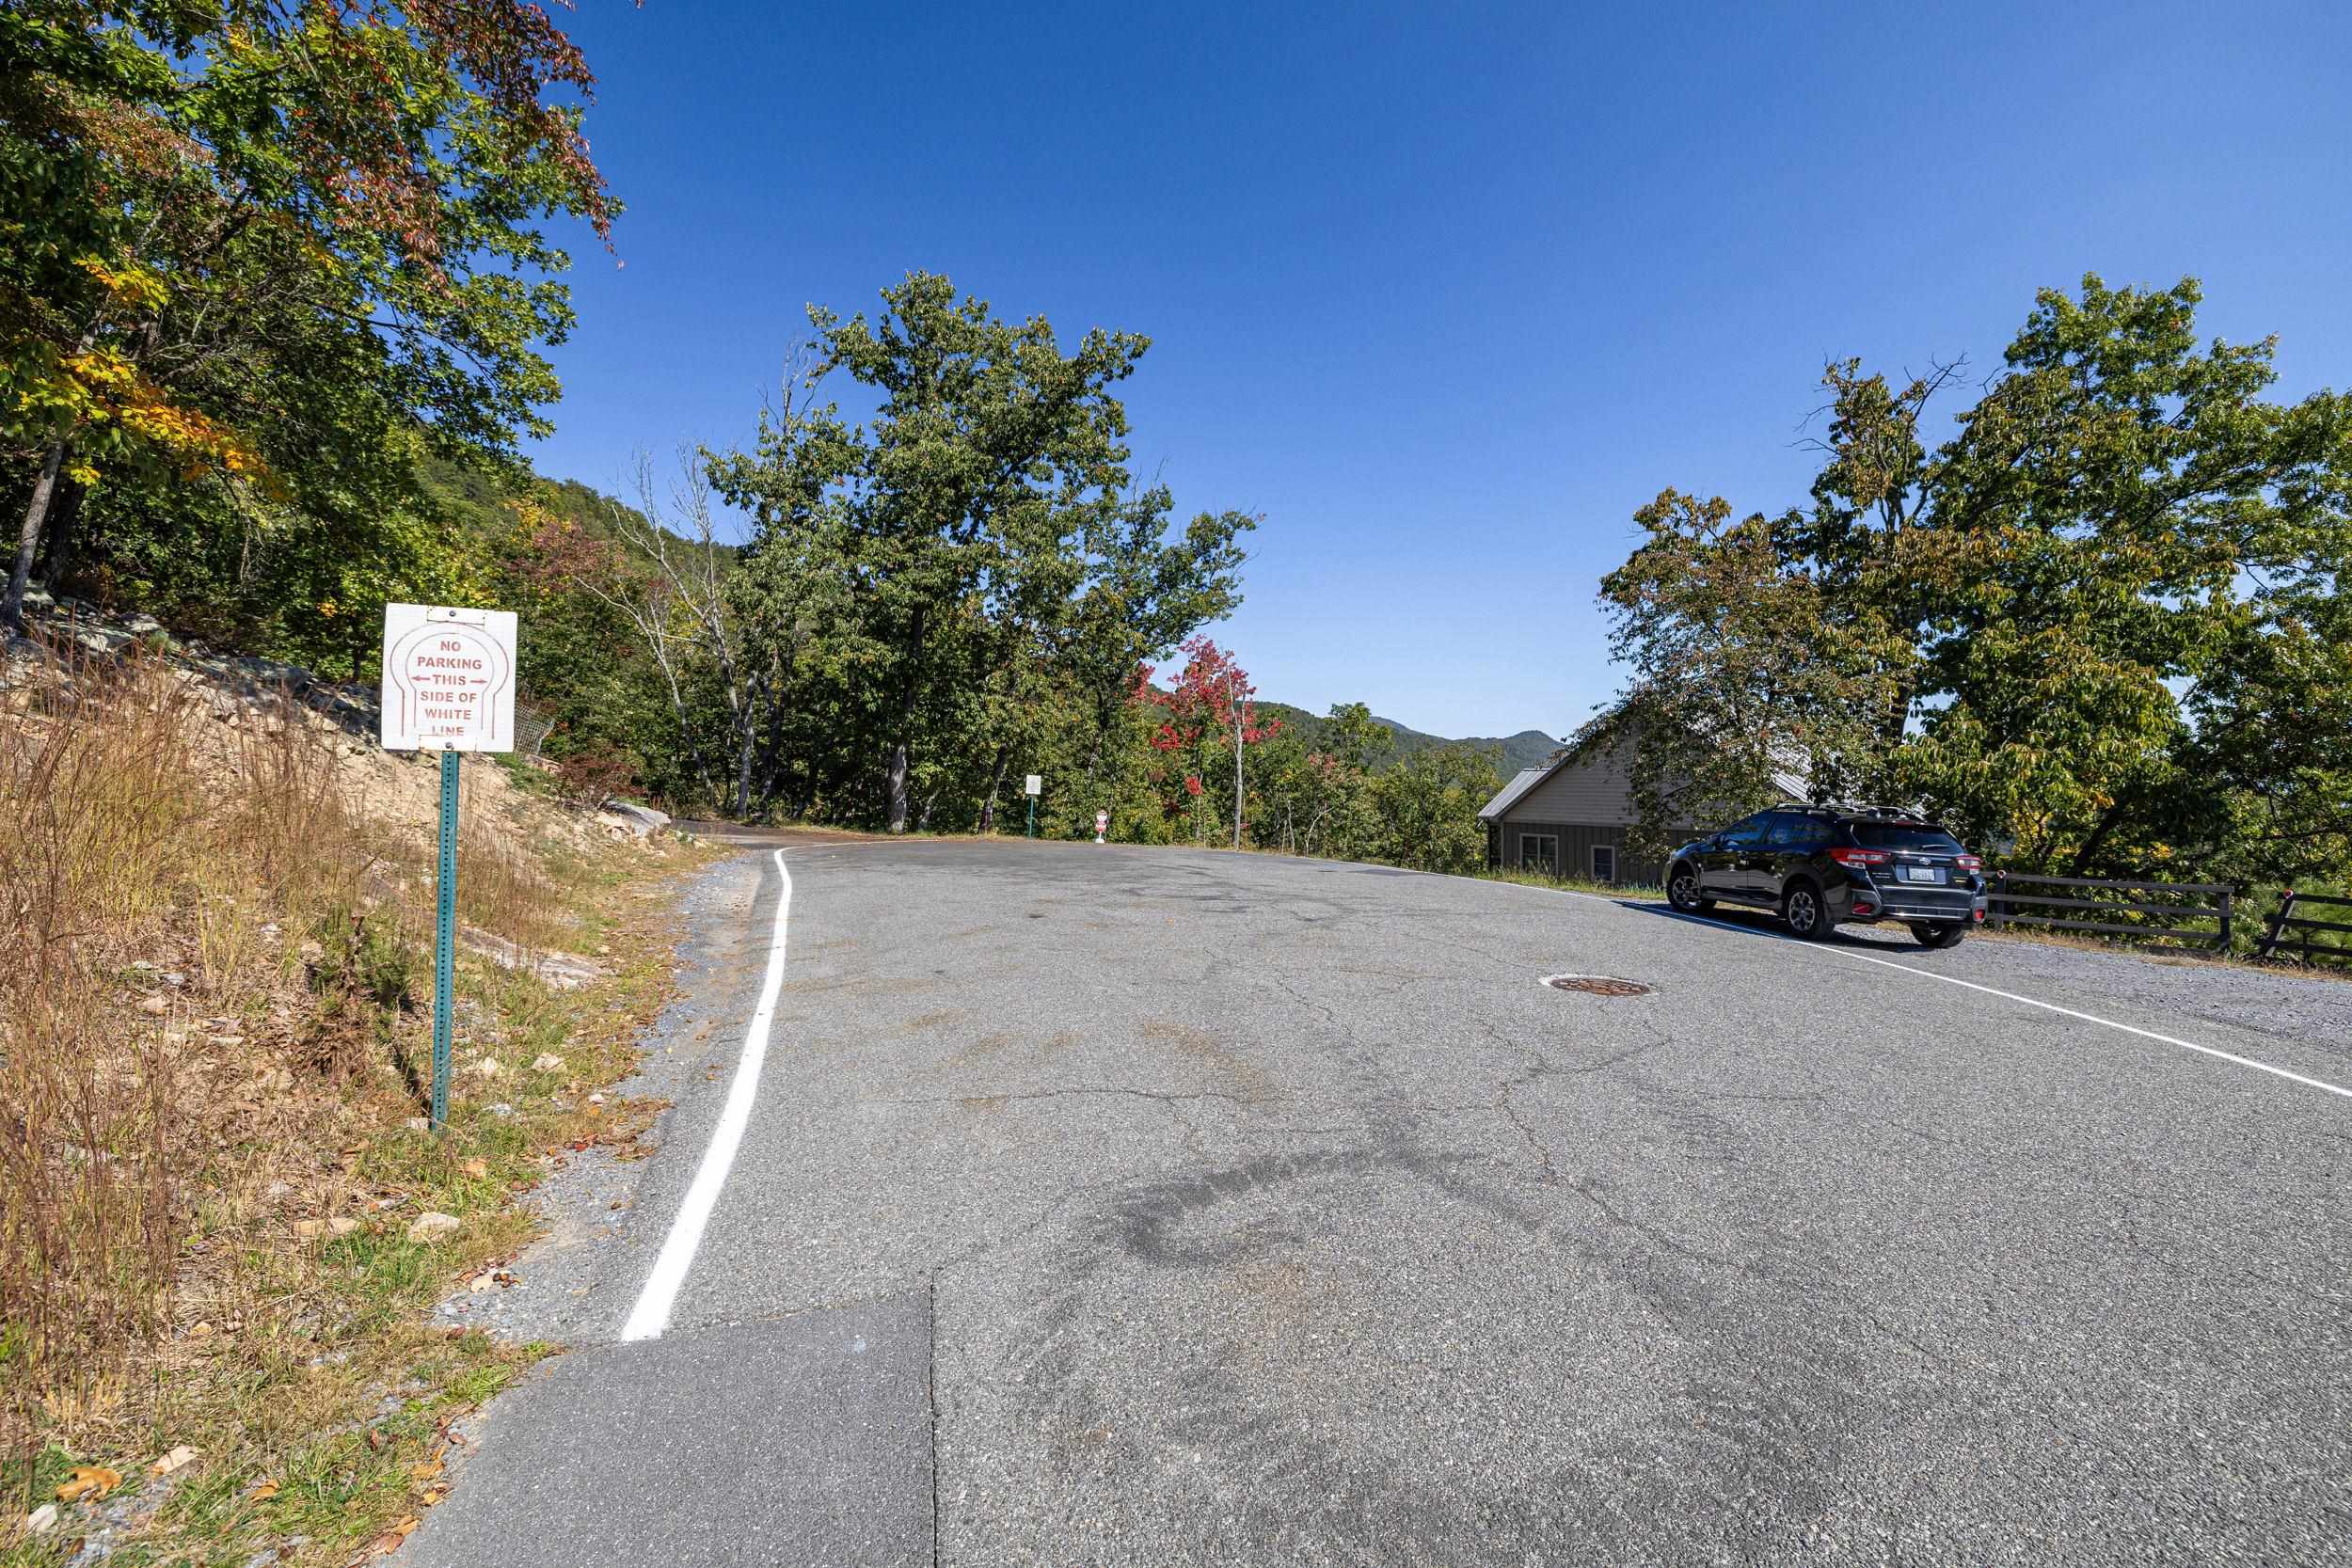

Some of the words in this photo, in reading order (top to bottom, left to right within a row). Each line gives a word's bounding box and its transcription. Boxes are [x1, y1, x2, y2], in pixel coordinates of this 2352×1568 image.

[440, 641, 461, 652] NO
[417, 656, 483, 670] PARKING
[433, 673, 467, 686] THIS
[421, 690, 453, 703] SIDE
[458, 692, 478, 704] OF
[424, 708, 471, 720] WHITE
